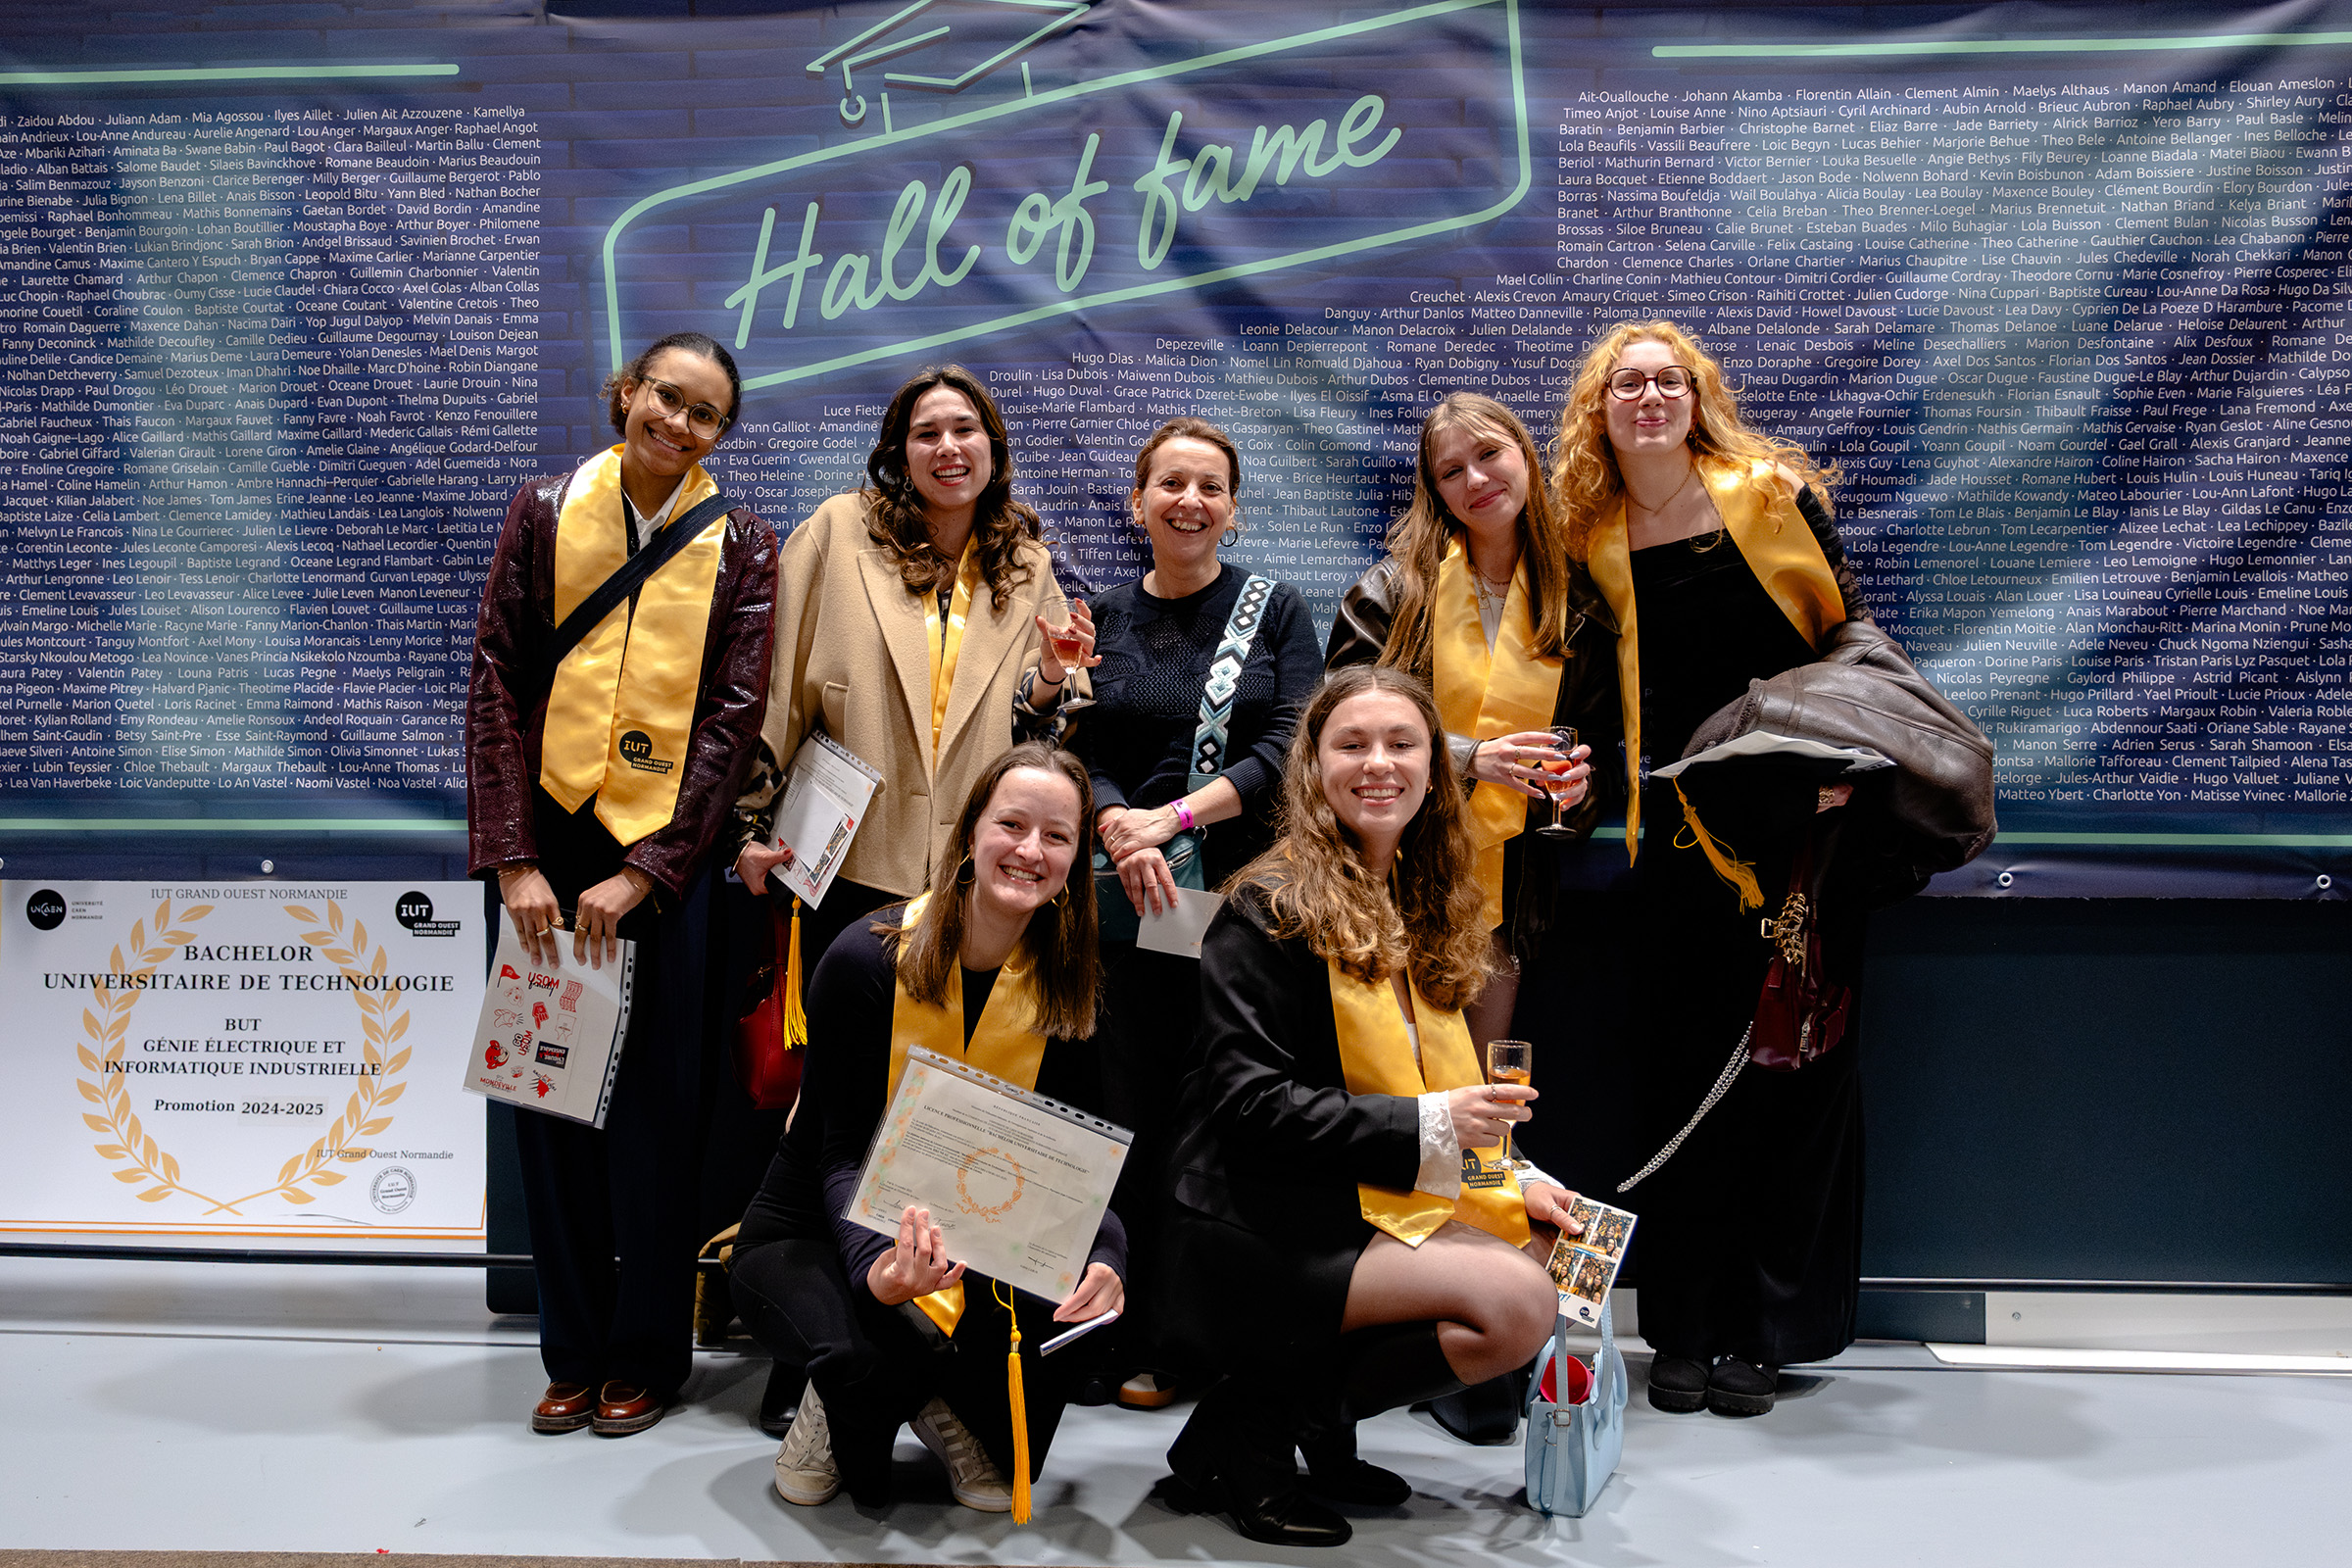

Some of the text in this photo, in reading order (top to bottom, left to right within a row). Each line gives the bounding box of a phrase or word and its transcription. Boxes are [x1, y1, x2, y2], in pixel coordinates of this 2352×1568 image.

[1578, 88, 1783, 103] Ait-Ouallouche Johann Akamba
[104, 111, 264, 125] Juliann Adam Mia Agossou
[312, 170, 501, 186] Milly Berger Guillaume Bergerot
[2104, 179, 2313, 197] Clément Bourdin Elory Bourdon
[725, 94, 1401, 349] Hall of fame
[47, 238, 223, 254] Valentin Brien Lukian Brindjonc
[1746, 253, 1968, 269] Orlane Chartier Marius Chaupitre
[304, 312, 493, 330] Yop Jugul Dalyop Melvin Danais
[1351, 322, 1455, 336] Manon Delacroix
[1155, 337, 1368, 354] Depezeville Loann Depierrepont
[1041, 367, 1215, 384] Lisa Dubois Maiwenn Dubois
[1947, 368, 2182, 386] Oscar Dugue Faustine Dugue-Le Blay
[165, 379, 318, 395] Léo Drouet Marion Drouet
[1829, 387, 1995, 404] Lkhagva-Ochir Erdenesukh
[740, 419, 810, 433] Yann Galliot
[305, 438, 538, 457] Amelie Glaine Angélique Godard-Delfour
[767, 435, 858, 452] Gregoire Godel
[1242, 454, 1396, 468] Noa Guilbert Sarah Guillo
[1292, 471, 1380, 484] Brice Heurtaut
[2129, 503, 2211, 518] Ianis Le Blay
[17, 524, 123, 540] Melvyn Le Francois
[289, 553, 433, 569] Oceane Legrand Flambart
[2158, 636, 2309, 653] Chuck Ngoma Nziengui
[351, 664, 445, 680] Maelys Peligrain
[1943, 687, 2133, 703] Leeloo Prenant Hugo Prillard
[33, 712, 198, 728] Kylian Rolland Emy Rondeau
[623, 740, 649, 754] IUT
[632, 762, 666, 773] NORMANDIE
[633, 757, 653, 765] GRAND
[295, 775, 436, 790] Naomi Vastel Noa Vastel
[2092, 787, 2285, 802] Charlotte Yon Matisse Yvinec
[151, 888, 348, 899] IUT GRAND OUEST NORMANDIE
[401, 905, 429, 916] IUT
[183, 945, 314, 961] BACHELOR
[44, 973, 454, 992] UNIVERSITAIRE DE TECHNOLOGIE
[528, 972, 560, 989] USOM
[224, 1018, 261, 1031] BUT
[143, 1038, 345, 1054] GÉNIE ÉLECTRIQUE ET
[513, 1033, 523, 1047] GO
[517, 1030, 533, 1055] USOM
[104, 1060, 381, 1077] INFORMATIQUE INDUSTRIELLE
[154, 1099, 323, 1116] Promotion 2024-2025
[316, 1149, 454, 1160] IUT Grand Ouest Normandie
